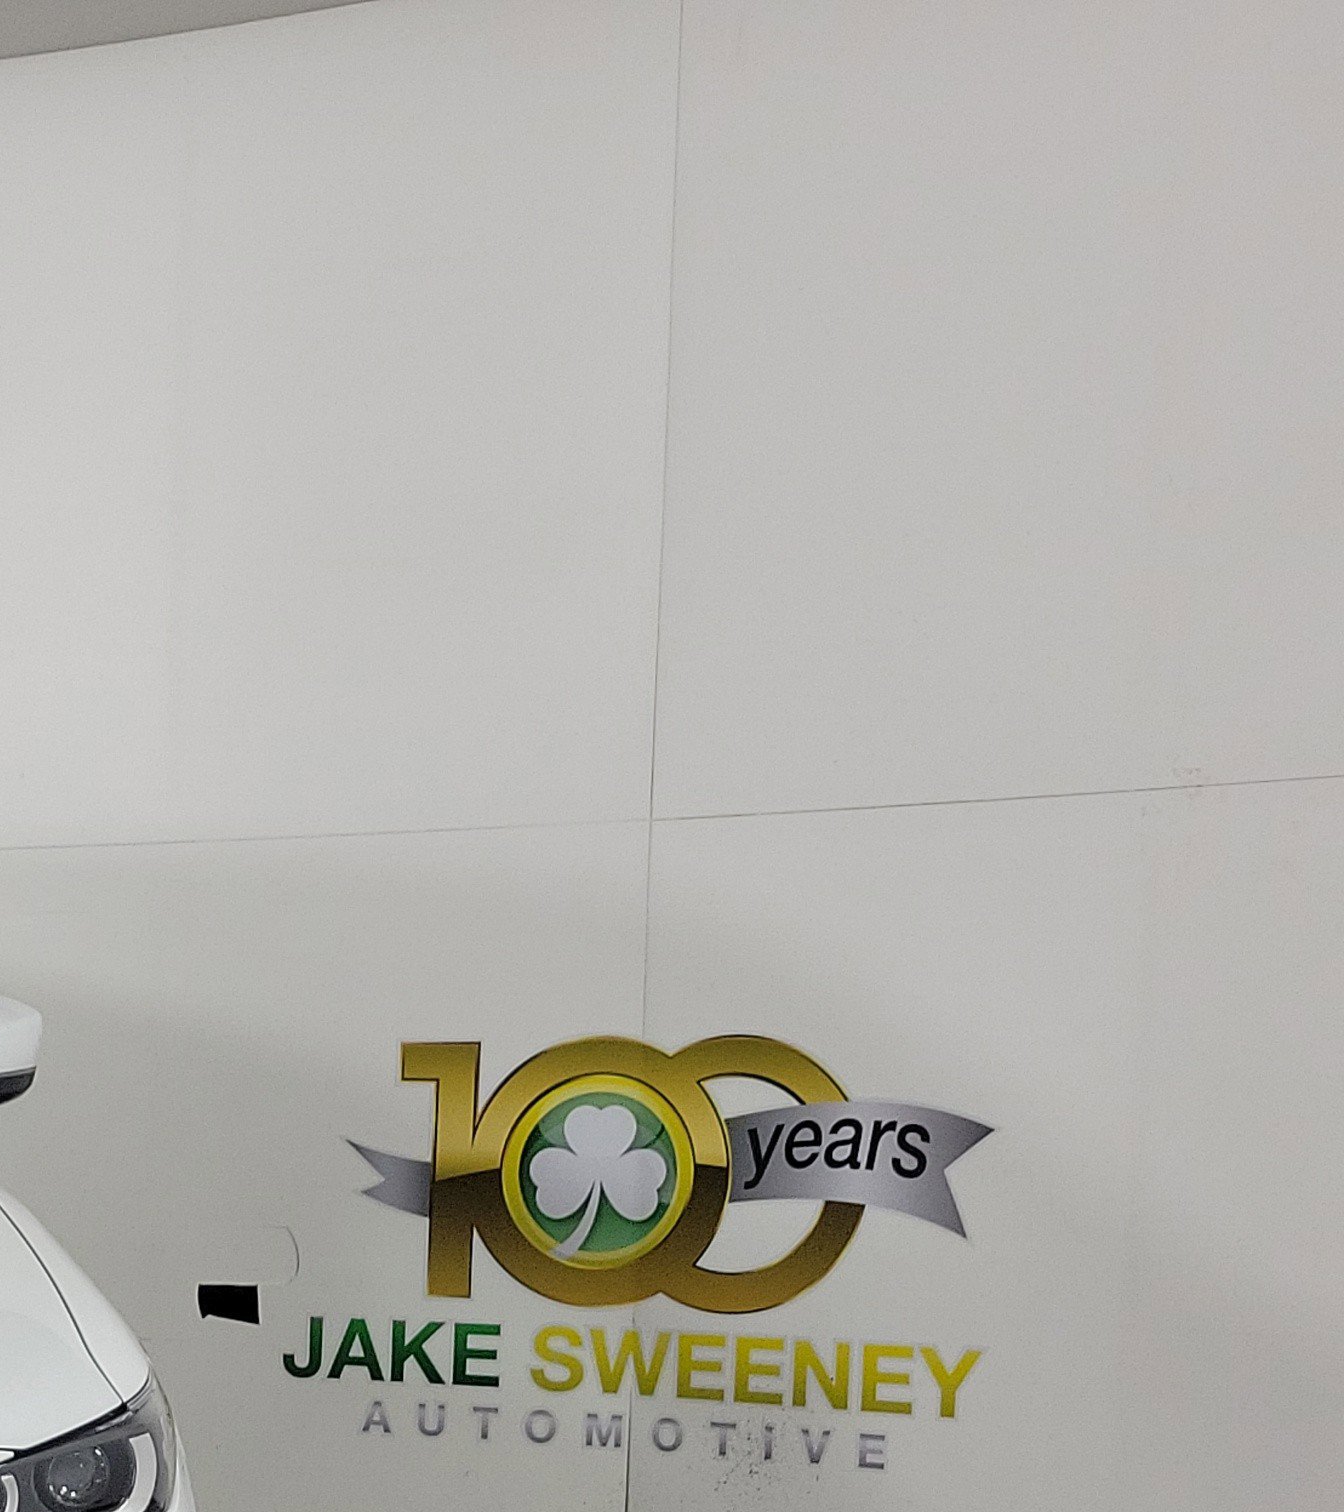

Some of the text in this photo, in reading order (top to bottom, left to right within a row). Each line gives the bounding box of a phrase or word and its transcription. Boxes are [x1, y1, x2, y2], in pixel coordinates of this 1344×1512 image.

[743, 1117, 930, 1190] years
[282, 1315, 982, 1419] JAKE SWEENEY
[361, 1400, 886, 1470] AUTOMOTIVE
